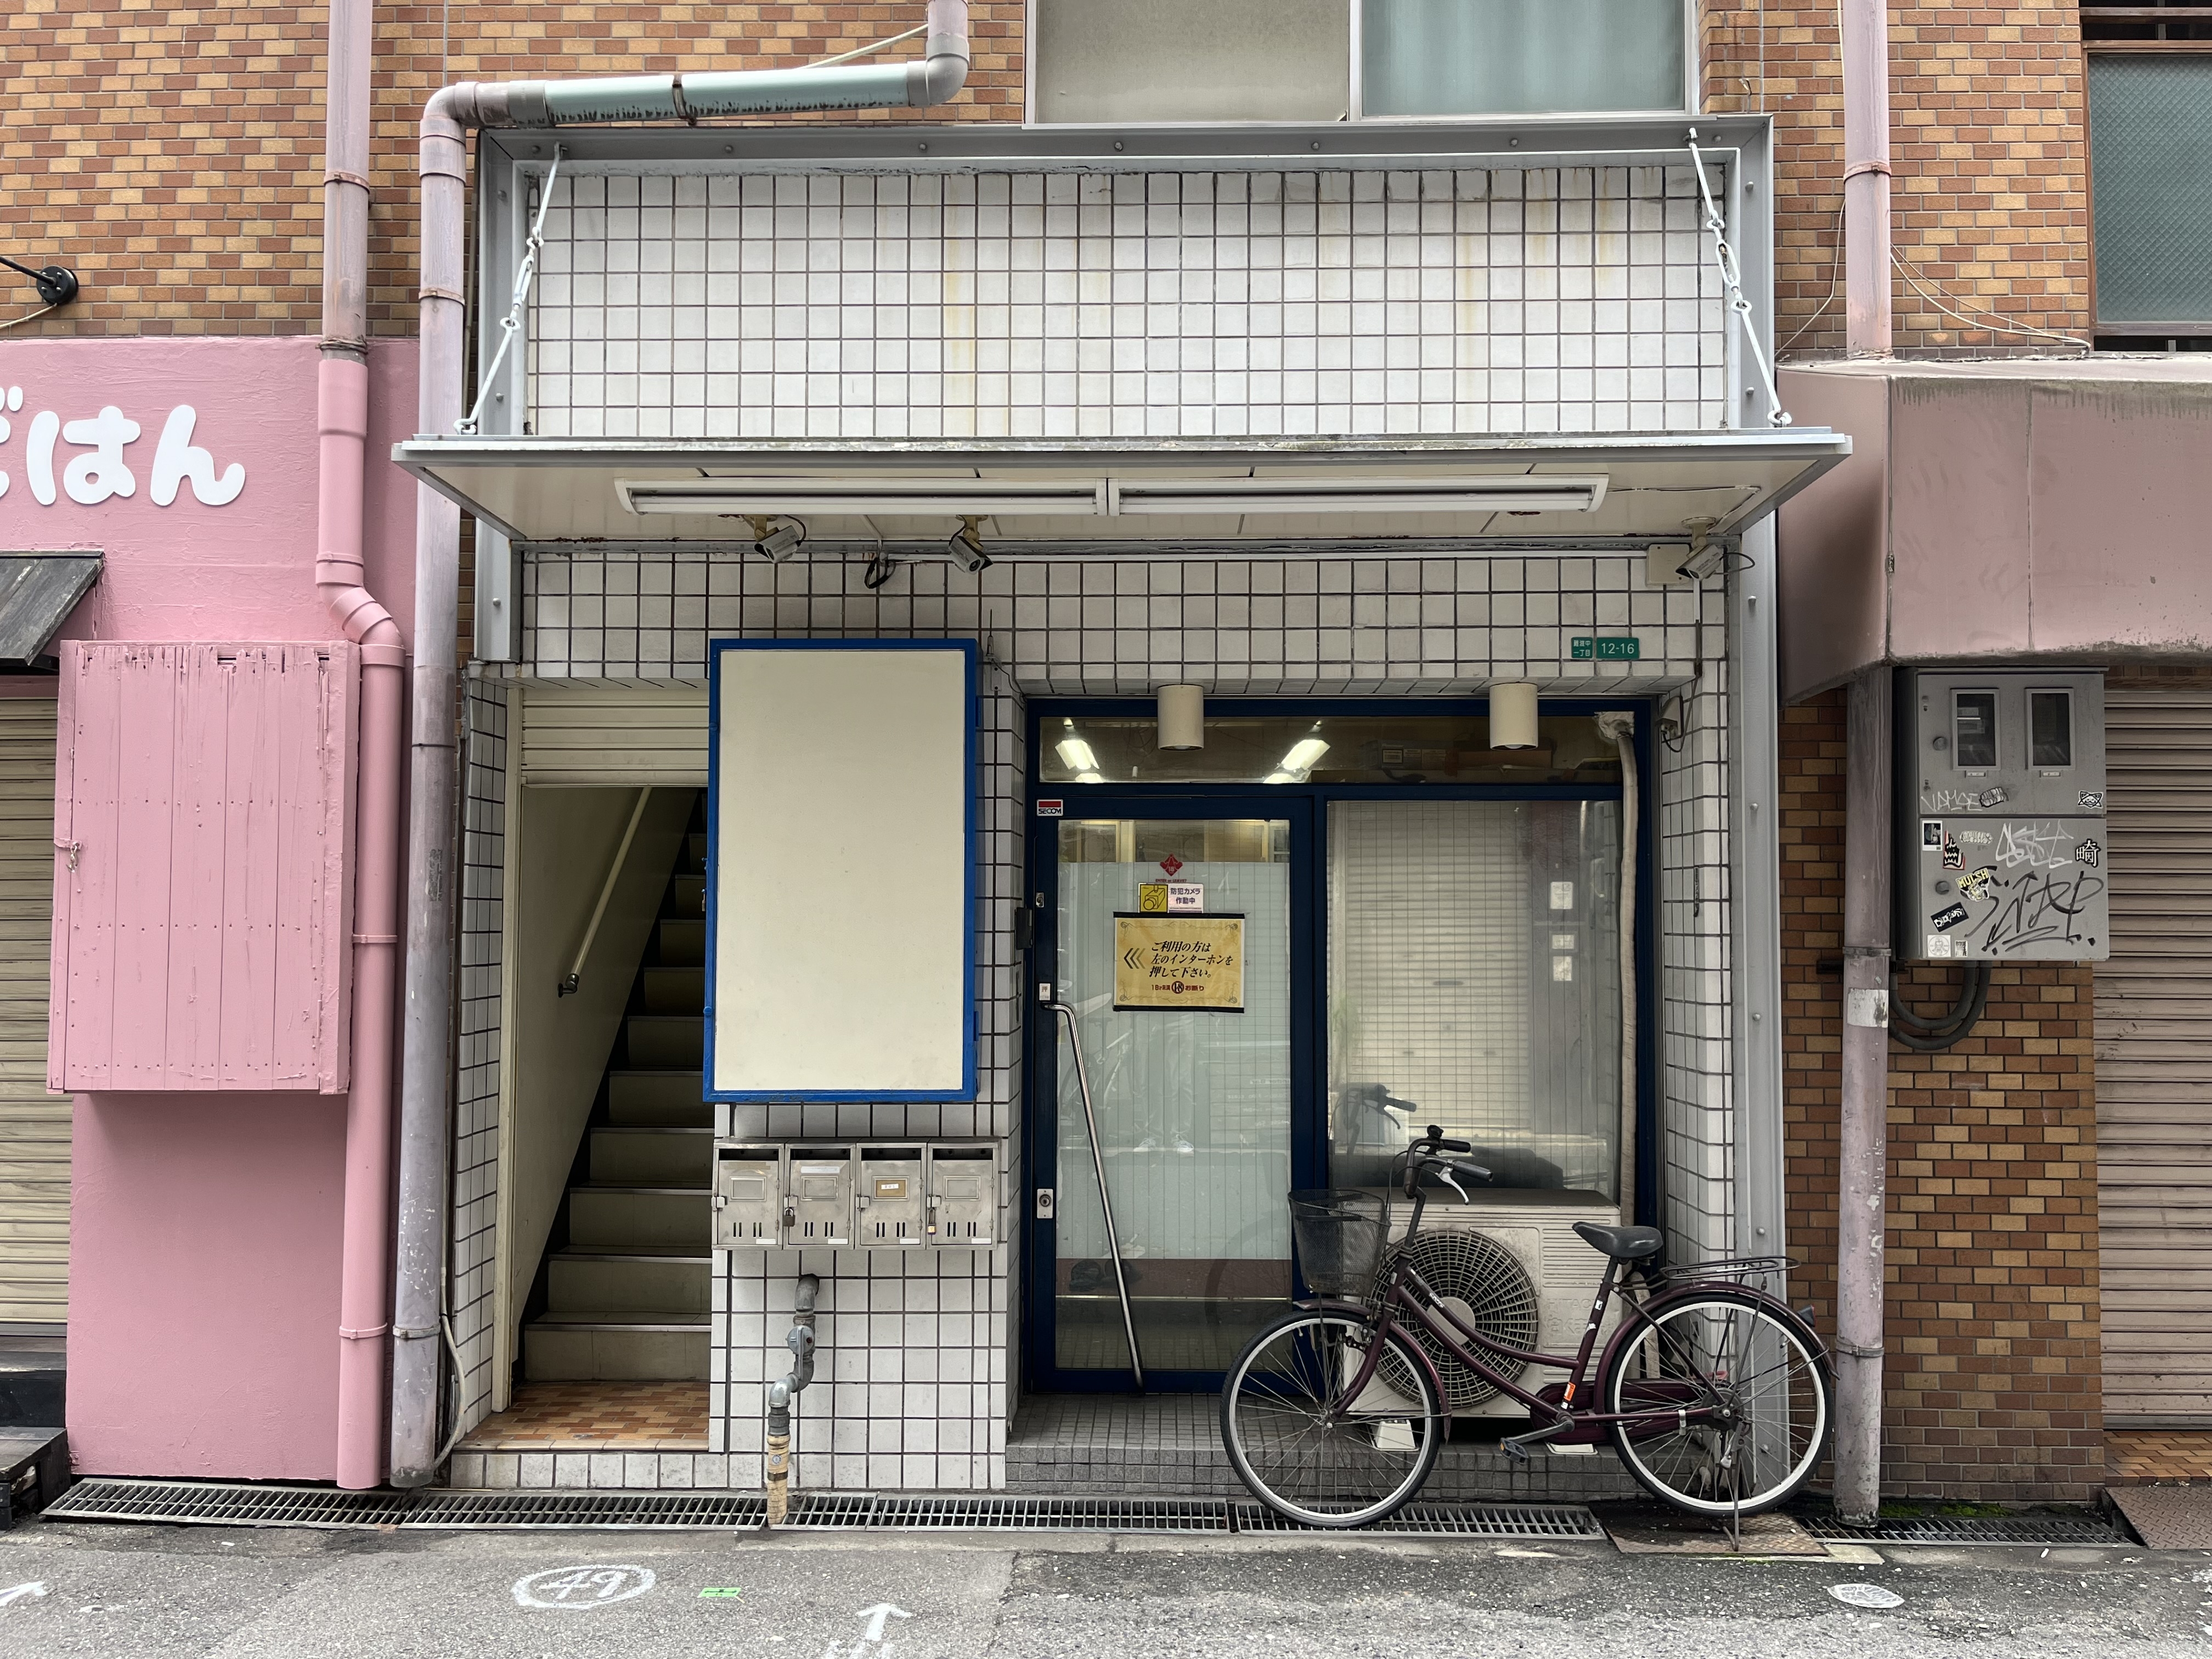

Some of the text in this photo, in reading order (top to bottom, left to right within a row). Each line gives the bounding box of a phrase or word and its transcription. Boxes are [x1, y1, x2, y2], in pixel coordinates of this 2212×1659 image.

[1601, 643, 1634, 654] 12-16
[1152, 940, 1211, 952] ご利用の方は
[1150, 953, 1233, 966] 左のインターホンを
[1149, 966, 1211, 978] 押して下さい。
[1547, 1299, 1598, 1310] HITAC
